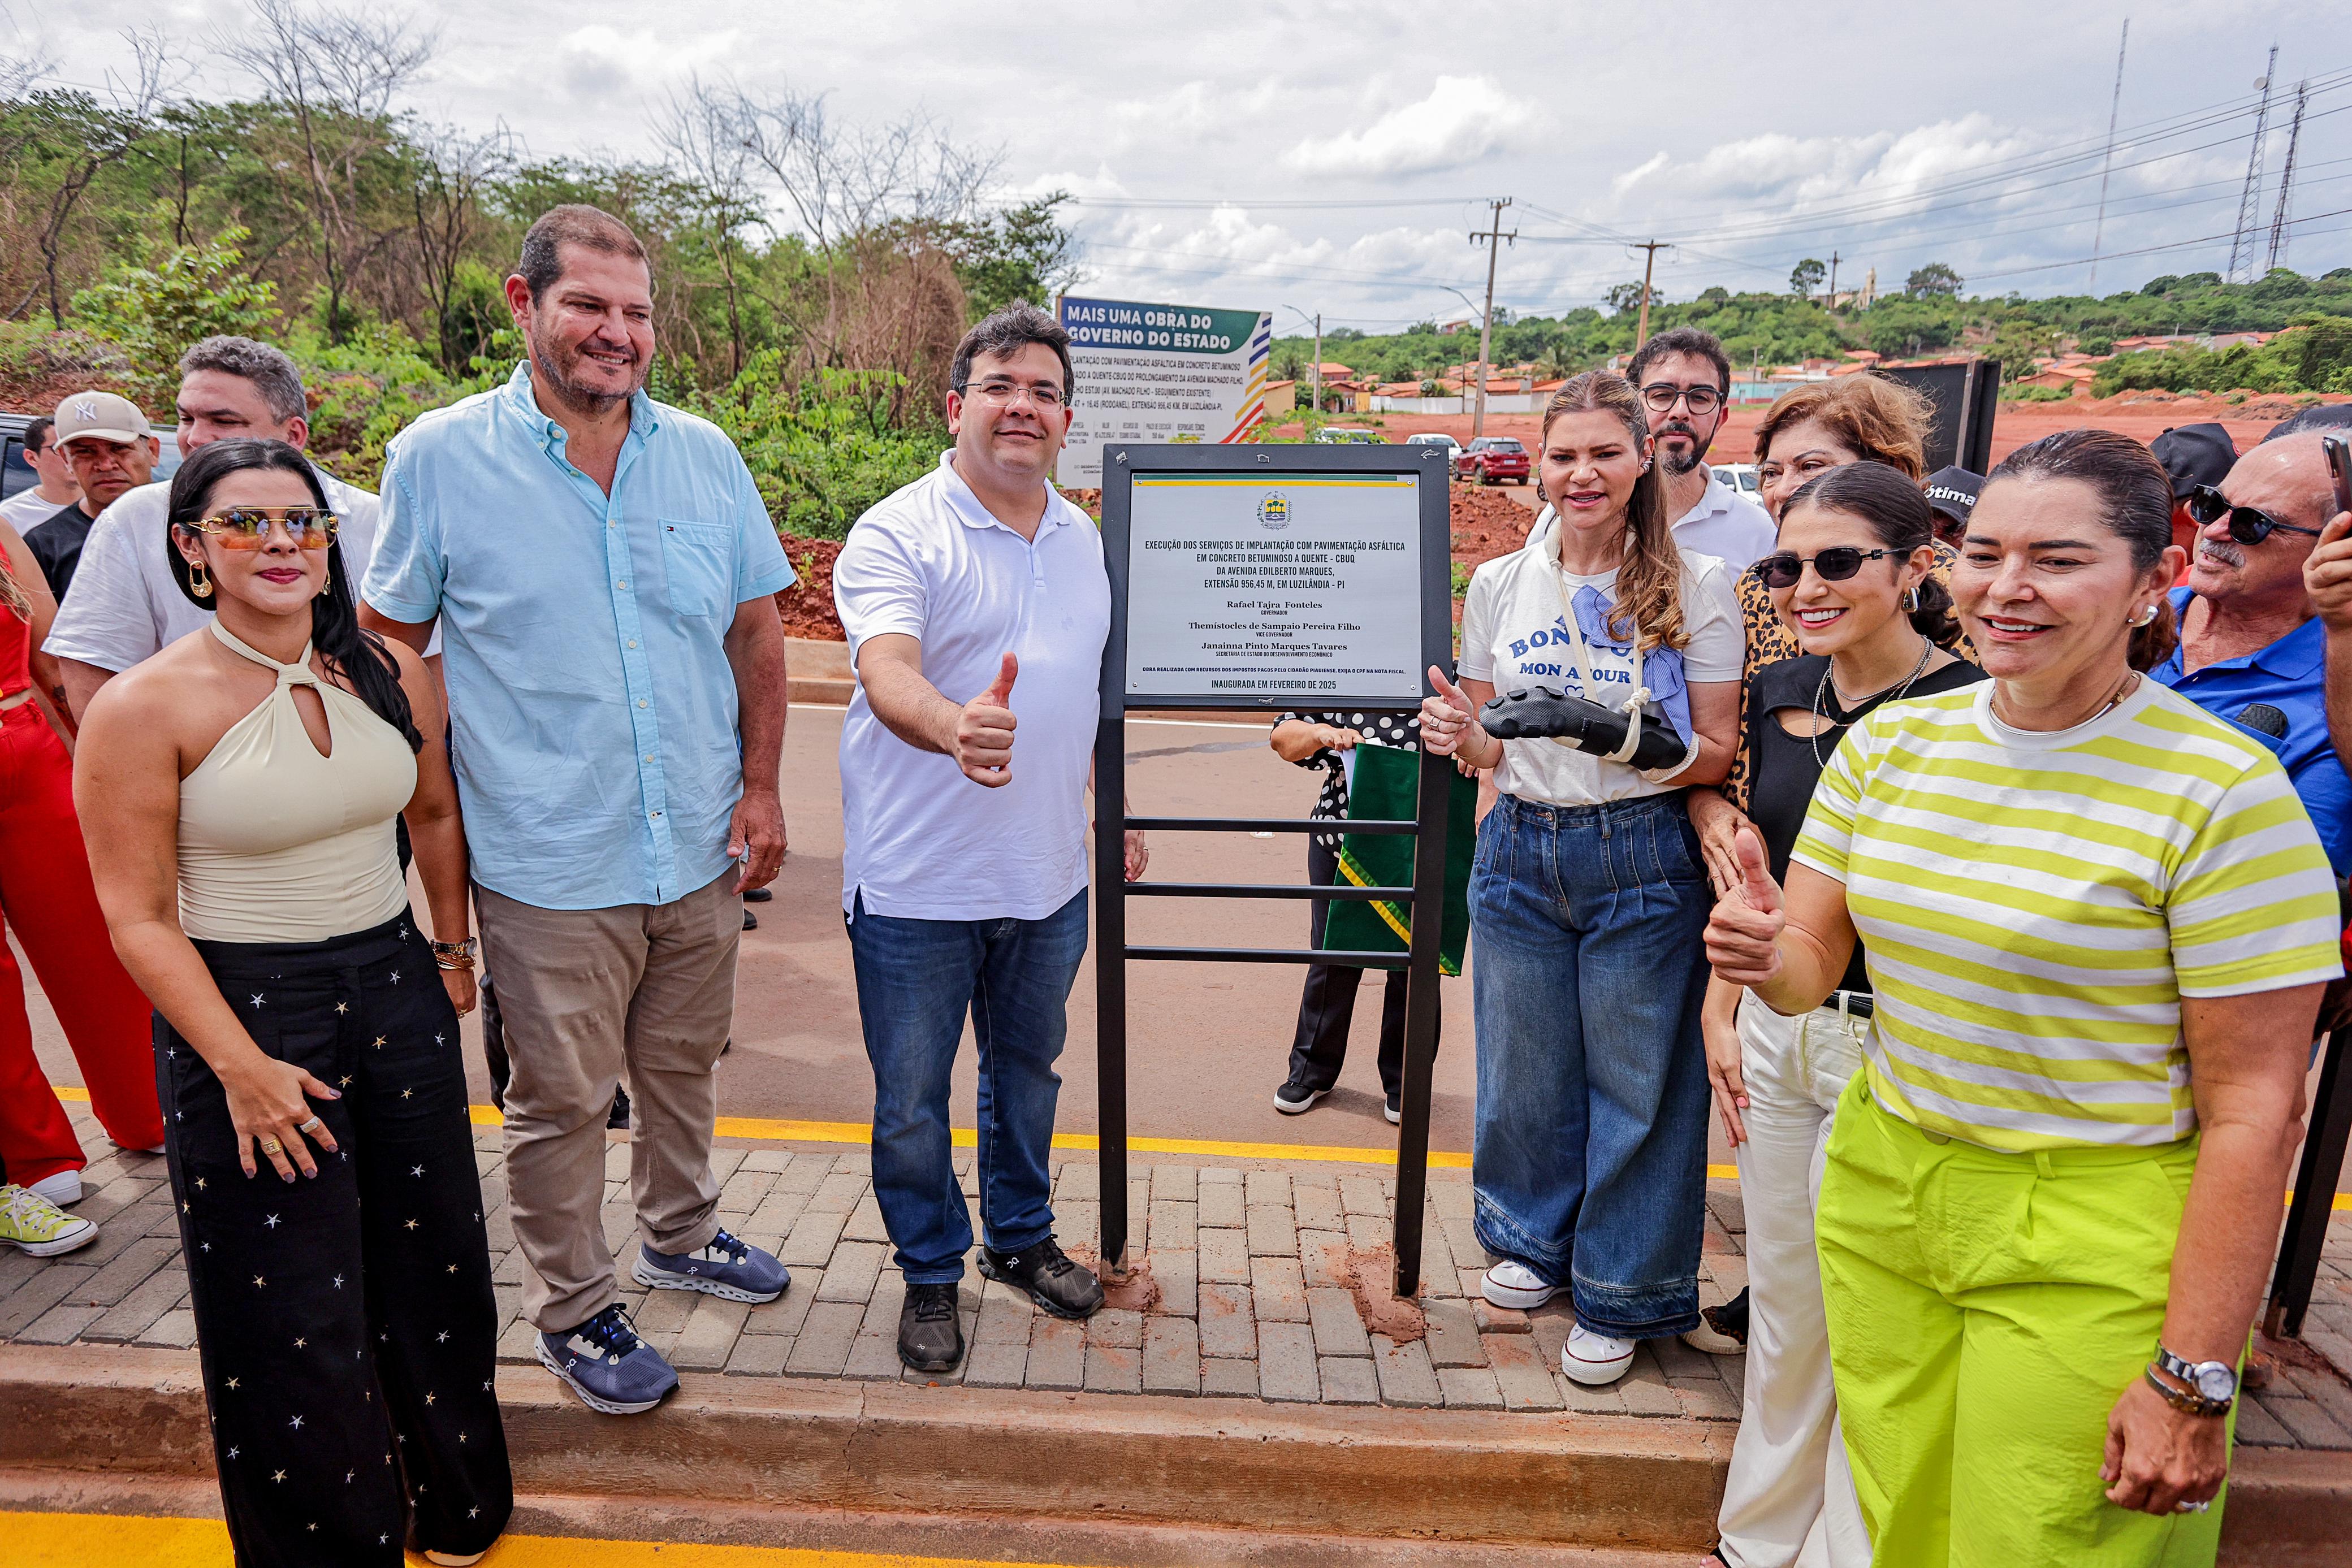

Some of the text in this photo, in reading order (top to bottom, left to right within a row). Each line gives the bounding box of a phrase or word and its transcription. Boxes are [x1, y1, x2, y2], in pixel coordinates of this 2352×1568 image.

[1067, 305, 1212, 330] MAIS UMA OBRA DO
[1067, 326, 1230, 350] GOVERNO DO ESTADO
[1070, 354, 1100, 367] PLANTAÇÃO
[1101, 357, 1112, 365] COM
[1113, 356, 1150, 369] PAVIMENTAÇÃO
[1151, 357, 1177, 368] ASFÁLTICA
[1186, 361, 1210, 370] CONCRETO
[1211, 362, 1241, 371] BETUMINOSO
[1087, 371, 1091, 379] A
[1127, 372, 1135, 380] DO
[1135, 373, 1178, 382] PROLONGAMENTO
[1112, 387, 1135, 395] MACHADO
[1132, 399, 1157, 409] EXTENSÃO
[1145, 539, 1405, 553] EXECUÇÃO DOS SERVIÇOS DE IMPLANTAÇÃO COM PAVIMENTAÇÃO ASFÁLTICA
[1196, 553, 1207, 562] EM
[1209, 553, 1246, 562] CONCRETO
[1248, 553, 1292, 563] BETUMINOSO
[1294, 554, 1299, 562] A
[1301, 554, 1328, 563] QUENTE
[1335, 554, 1355, 564] CBUQ
[1216, 566, 1335, 577] DA AVENIDA EDILBERTO MARQUES,
[1204, 578, 1239, 588] EXTENSÃO
[1241, 579, 1265, 590] 956,45
[1266, 579, 1275, 590] M,
[1277, 579, 1287, 588] EM
[1289, 578, 1330, 589] LUZILÂNDIA
[1337, 580, 1344, 589] PI
[1256, 601, 1281, 610] Tajra
[1261, 622, 1300, 631] Sampaio
[1270, 643, 1311, 651] Marques
[1519, 662, 1631, 684] MON AOUR
[1212, 679, 1337, 690] INAUGURADA EM FEVEREIRO DE 2025
